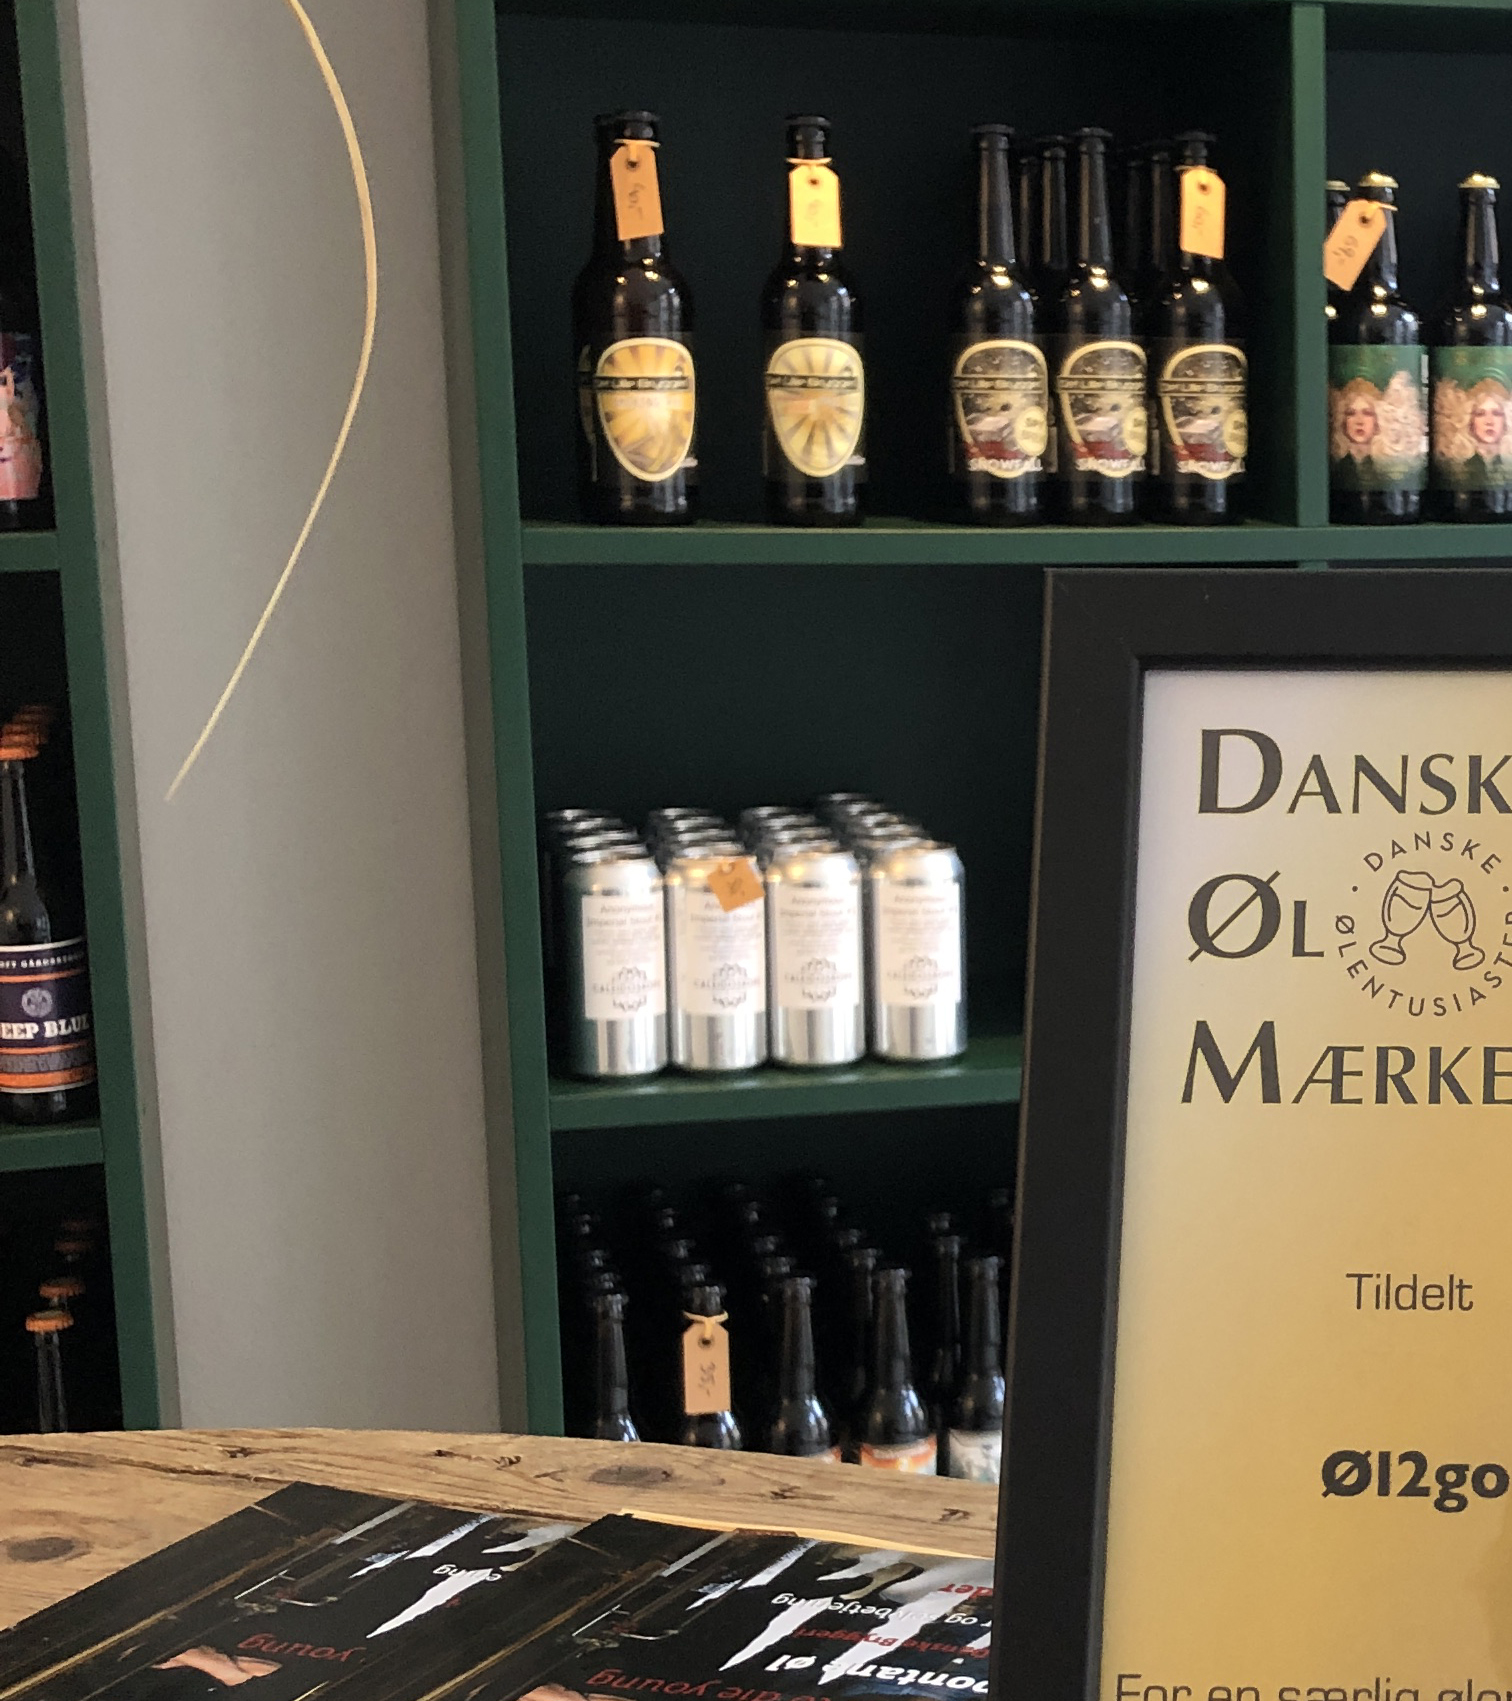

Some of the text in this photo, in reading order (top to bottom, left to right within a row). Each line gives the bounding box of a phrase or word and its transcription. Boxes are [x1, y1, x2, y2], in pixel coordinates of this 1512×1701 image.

[1363, 830, 1503, 876] DANSKE
[1187, 869, 1325, 962] ØL
[0, 1022, 39, 1040] EEP
[1346, 1273, 1475, 1312] Tildelt
[944, 1612, 978, 1626] og
[238, 1632, 367, 1662] young
[764, 1654, 818, 1672] øl
[585, 1668, 722, 1699] young
